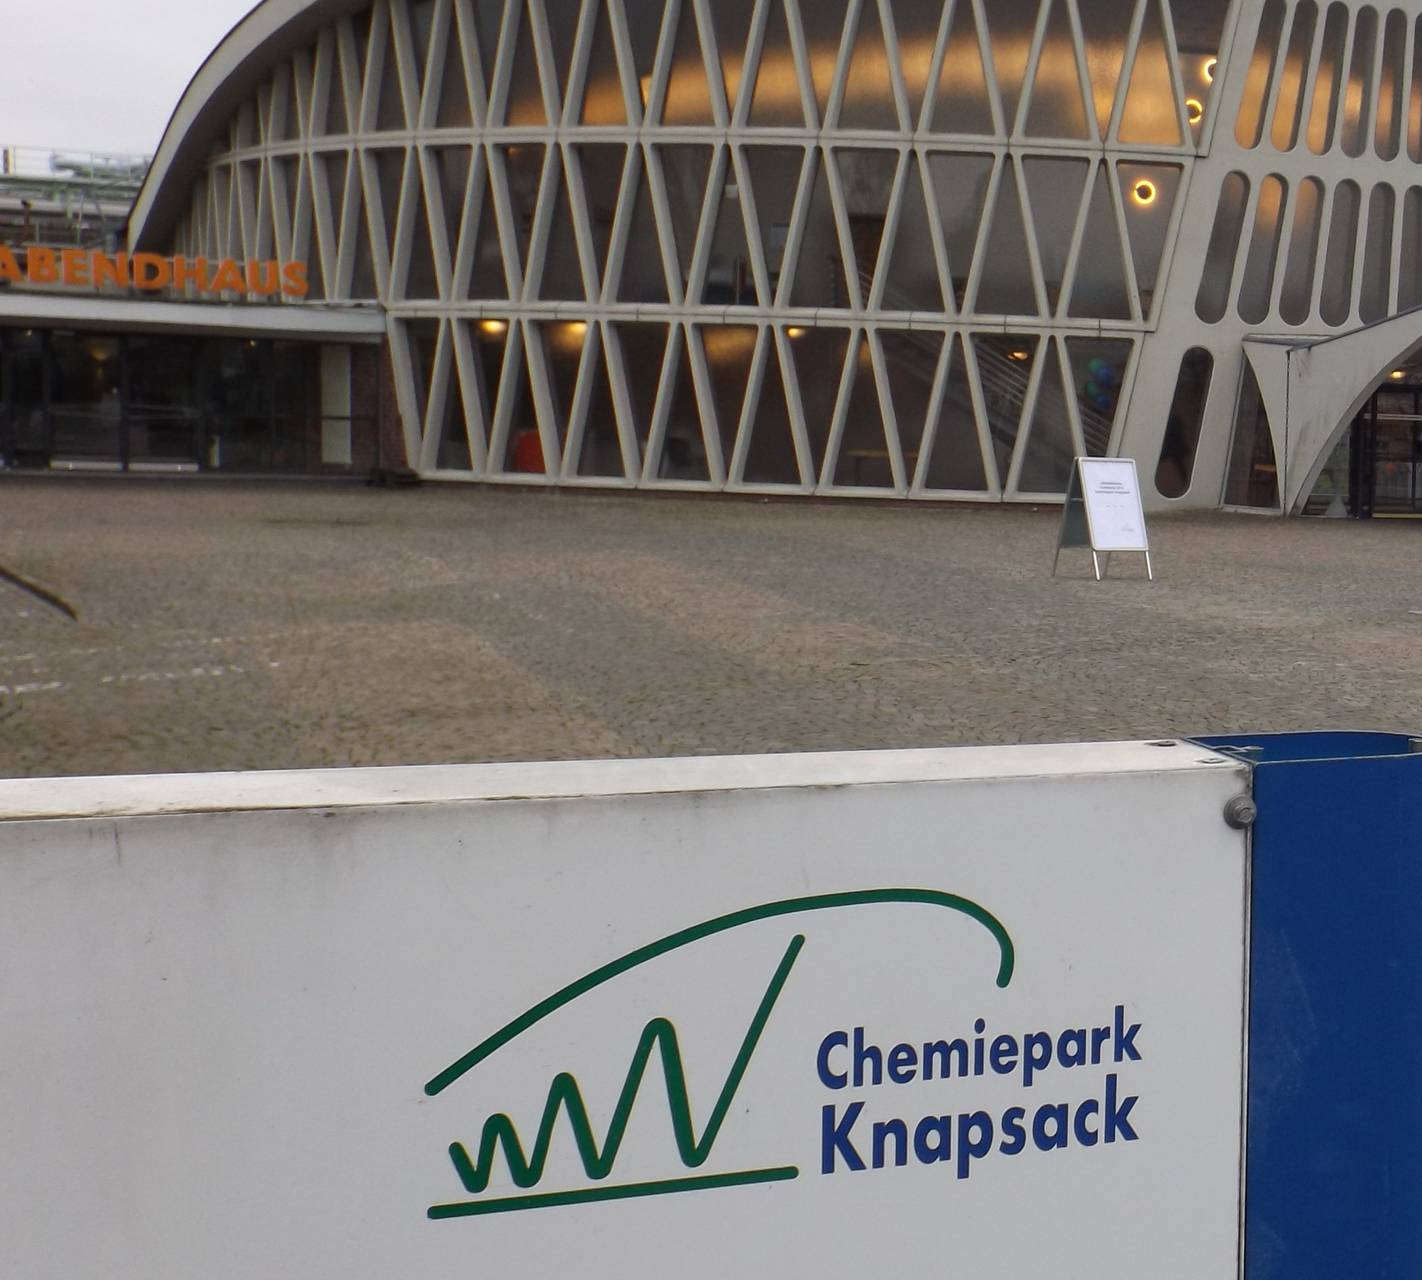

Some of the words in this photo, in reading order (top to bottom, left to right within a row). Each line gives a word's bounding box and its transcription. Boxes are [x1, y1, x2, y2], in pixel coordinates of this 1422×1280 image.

[0, 243, 309, 297] ABENDHAUS
[817, 1005, 1142, 1090] Chemiepark
[821, 1074, 1140, 1179] Knapsack
